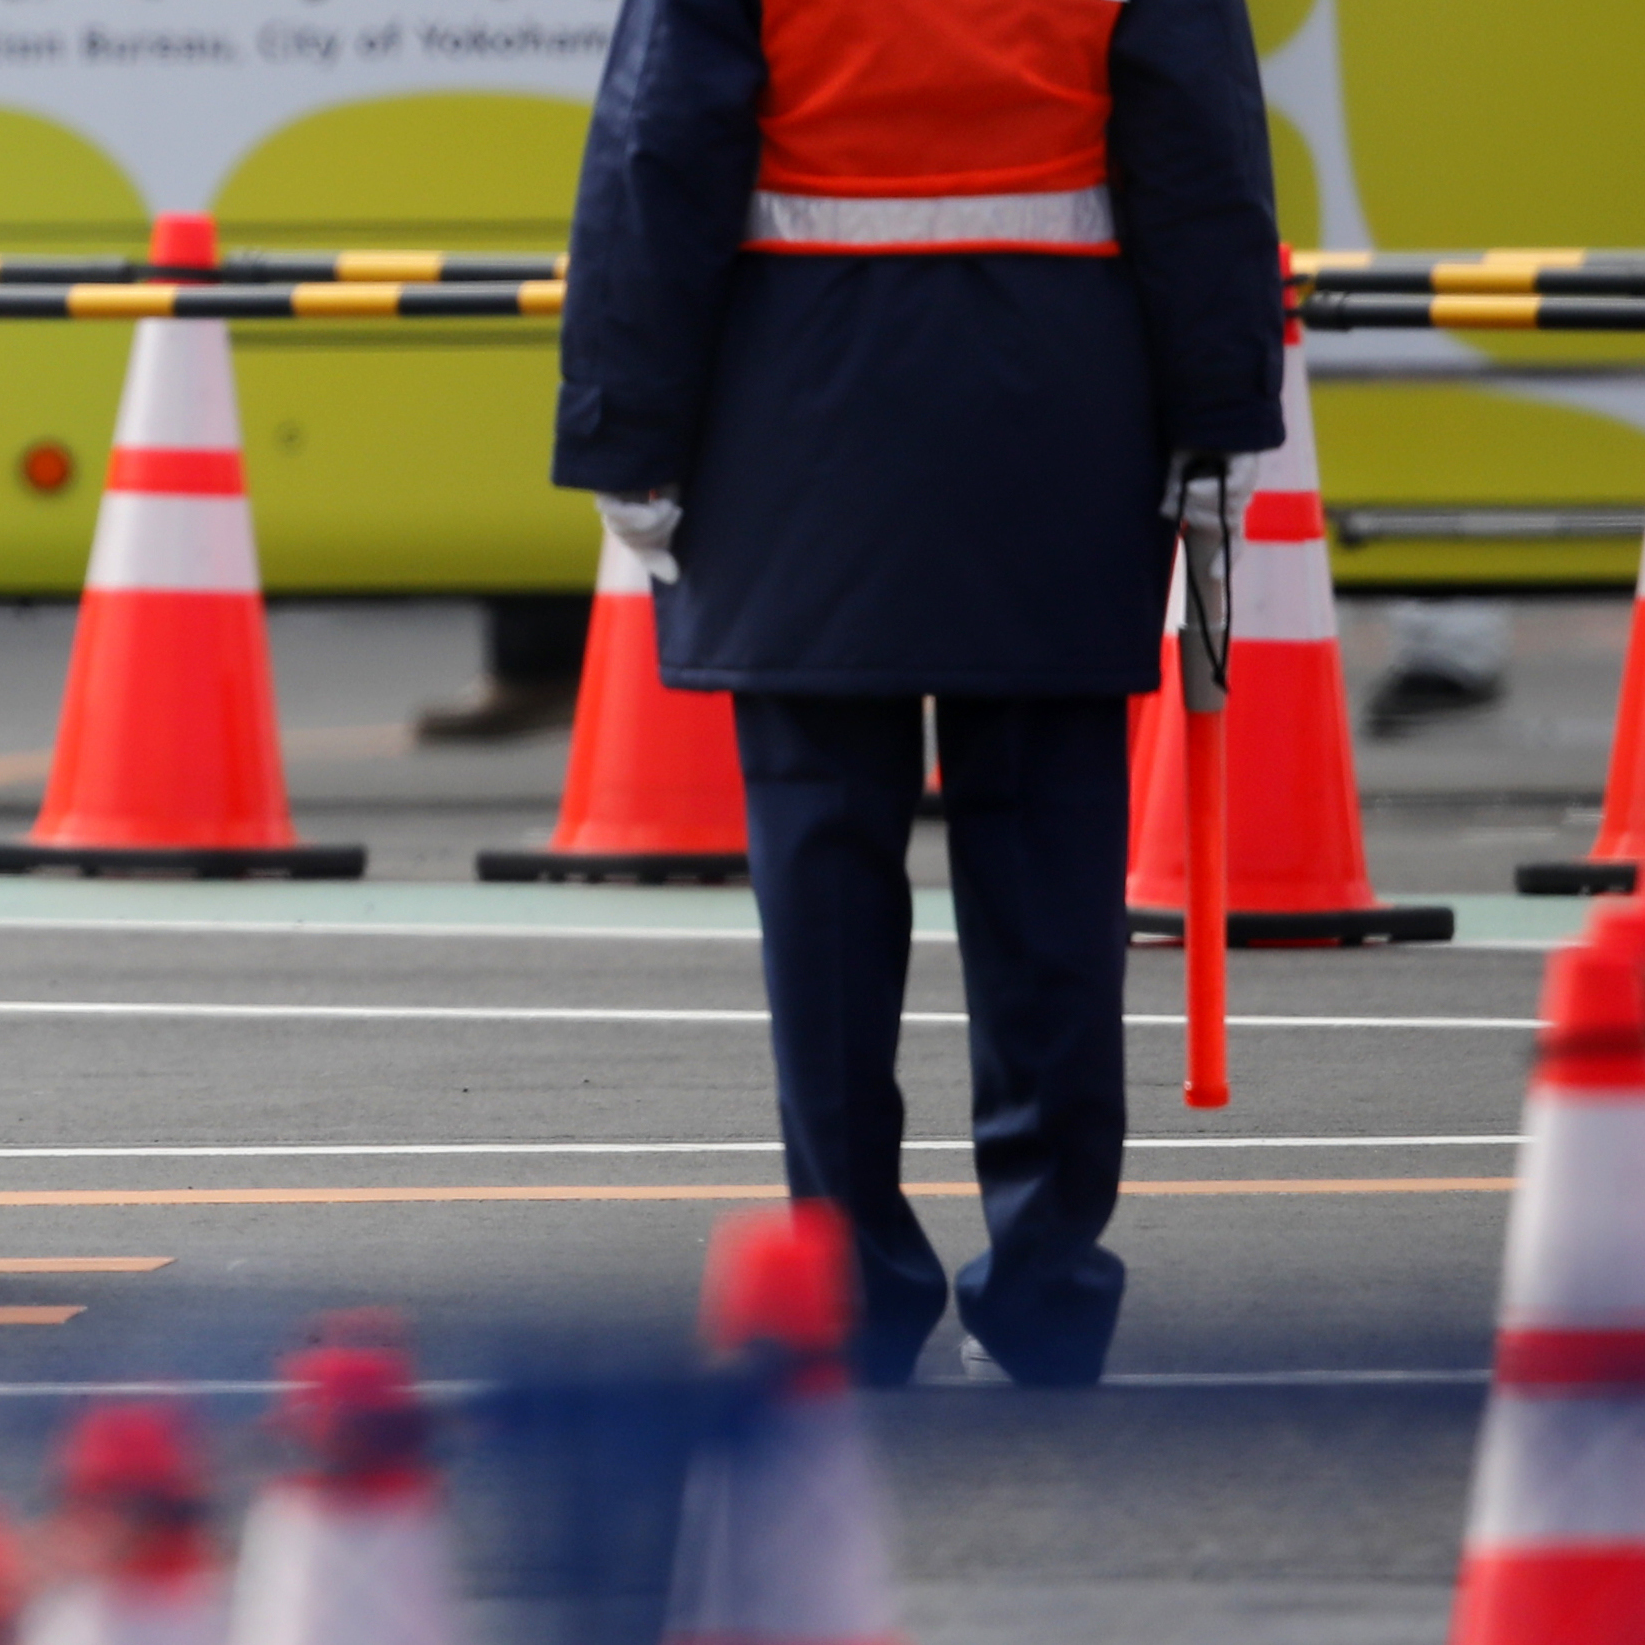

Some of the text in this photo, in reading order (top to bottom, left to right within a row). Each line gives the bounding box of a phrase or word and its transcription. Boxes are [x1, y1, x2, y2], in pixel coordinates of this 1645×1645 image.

[257, 23, 341, 66] City
[358, 21, 401, 61] of
[417, 19, 612, 60] Yokoham
